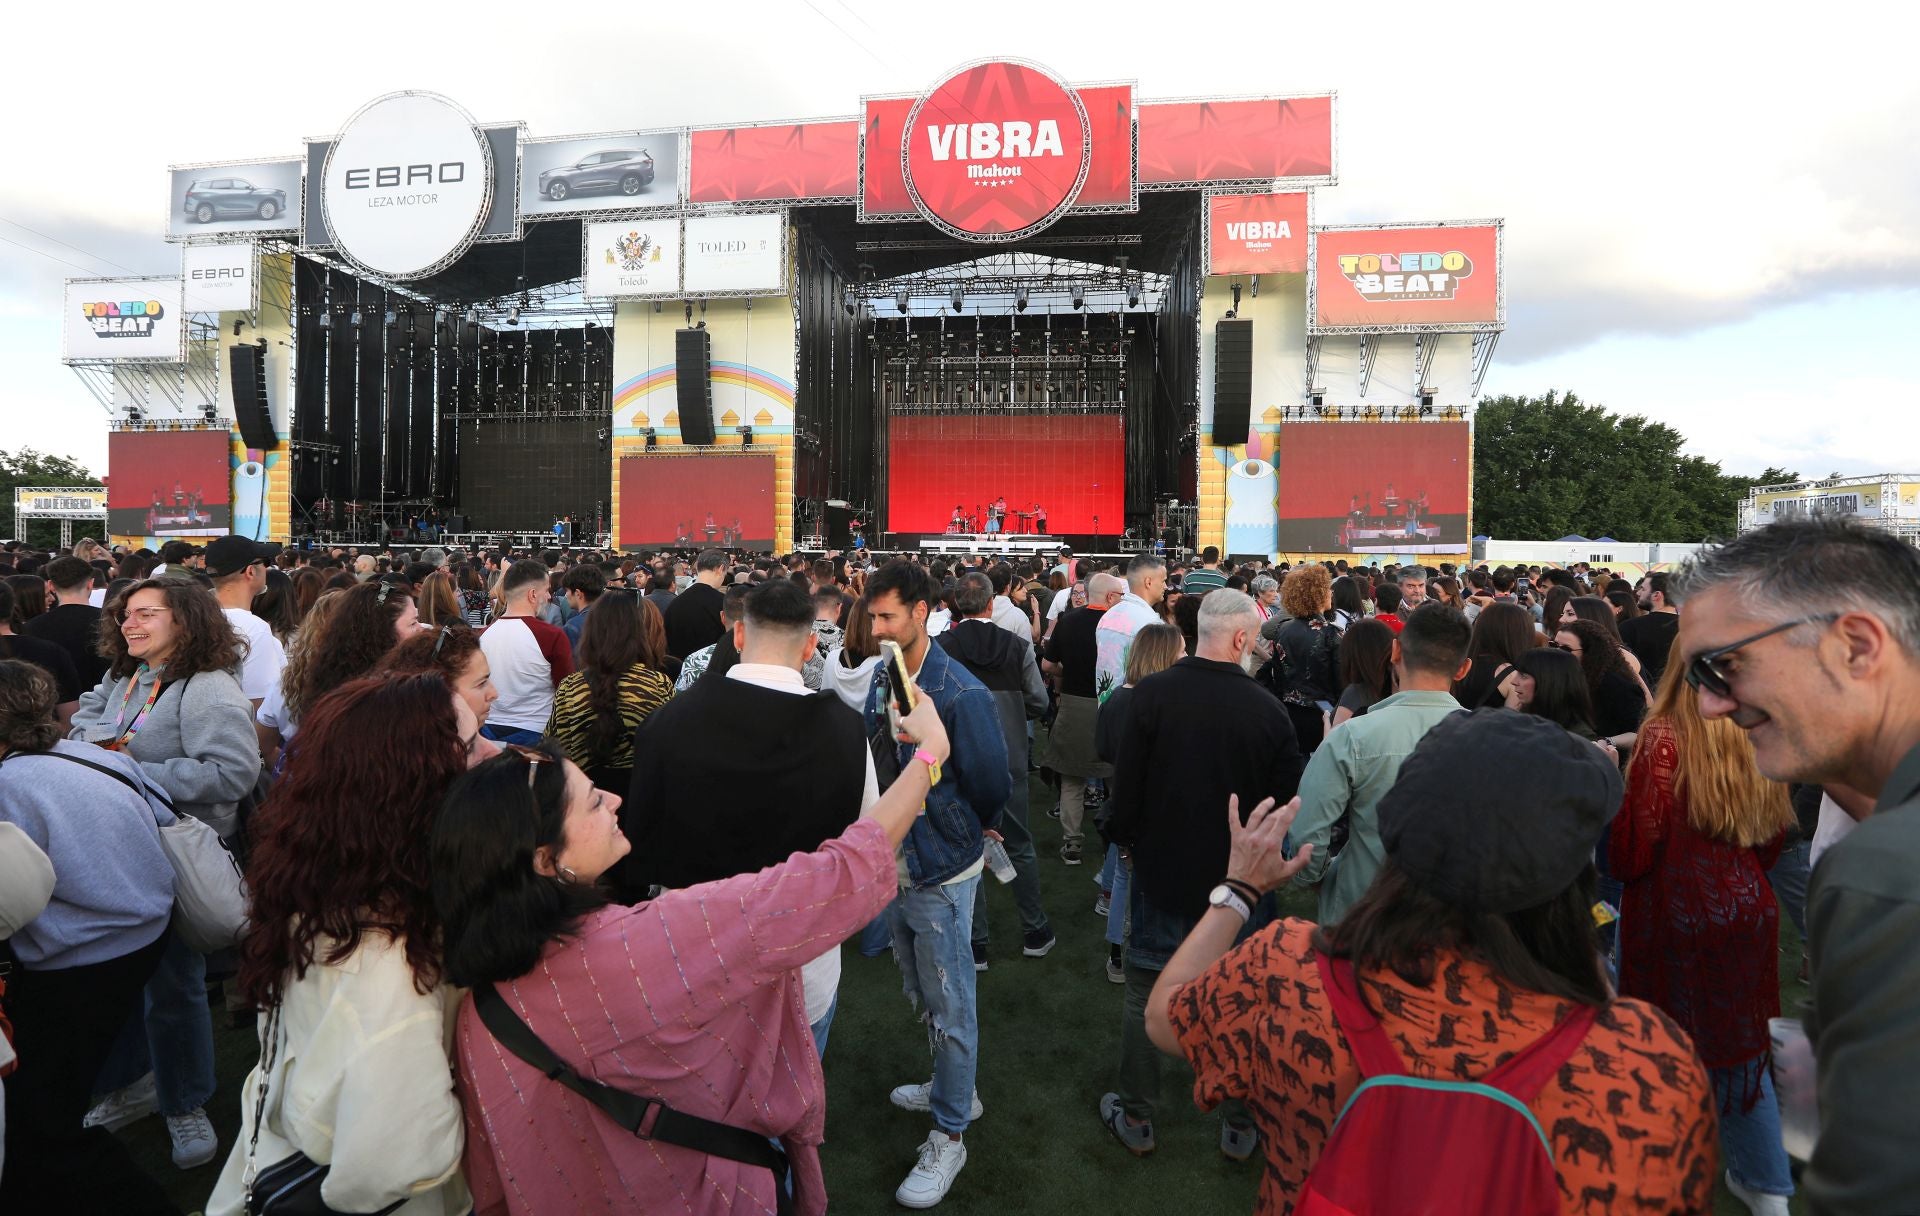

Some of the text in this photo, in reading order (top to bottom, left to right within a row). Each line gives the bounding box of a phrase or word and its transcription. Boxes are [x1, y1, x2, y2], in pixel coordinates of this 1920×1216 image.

[927, 119, 1064, 161] VIBRA
[345, 162, 465, 190] EBRO
[966, 163, 1022, 179] Mahou
[368, 193, 438, 208] LEZA MOTOR
[1225, 220, 1292, 241] VIBRA
[697, 240, 746, 253] TOLED
[1340, 252, 1465, 274] TOLEDO
[192, 267, 244, 280] EBRO
[618, 275, 648, 287] Toledo
[1355, 273, 1449, 293] BEAT
[82, 300, 160, 317] TOLEDO
[91, 317, 150, 333] BEAT
